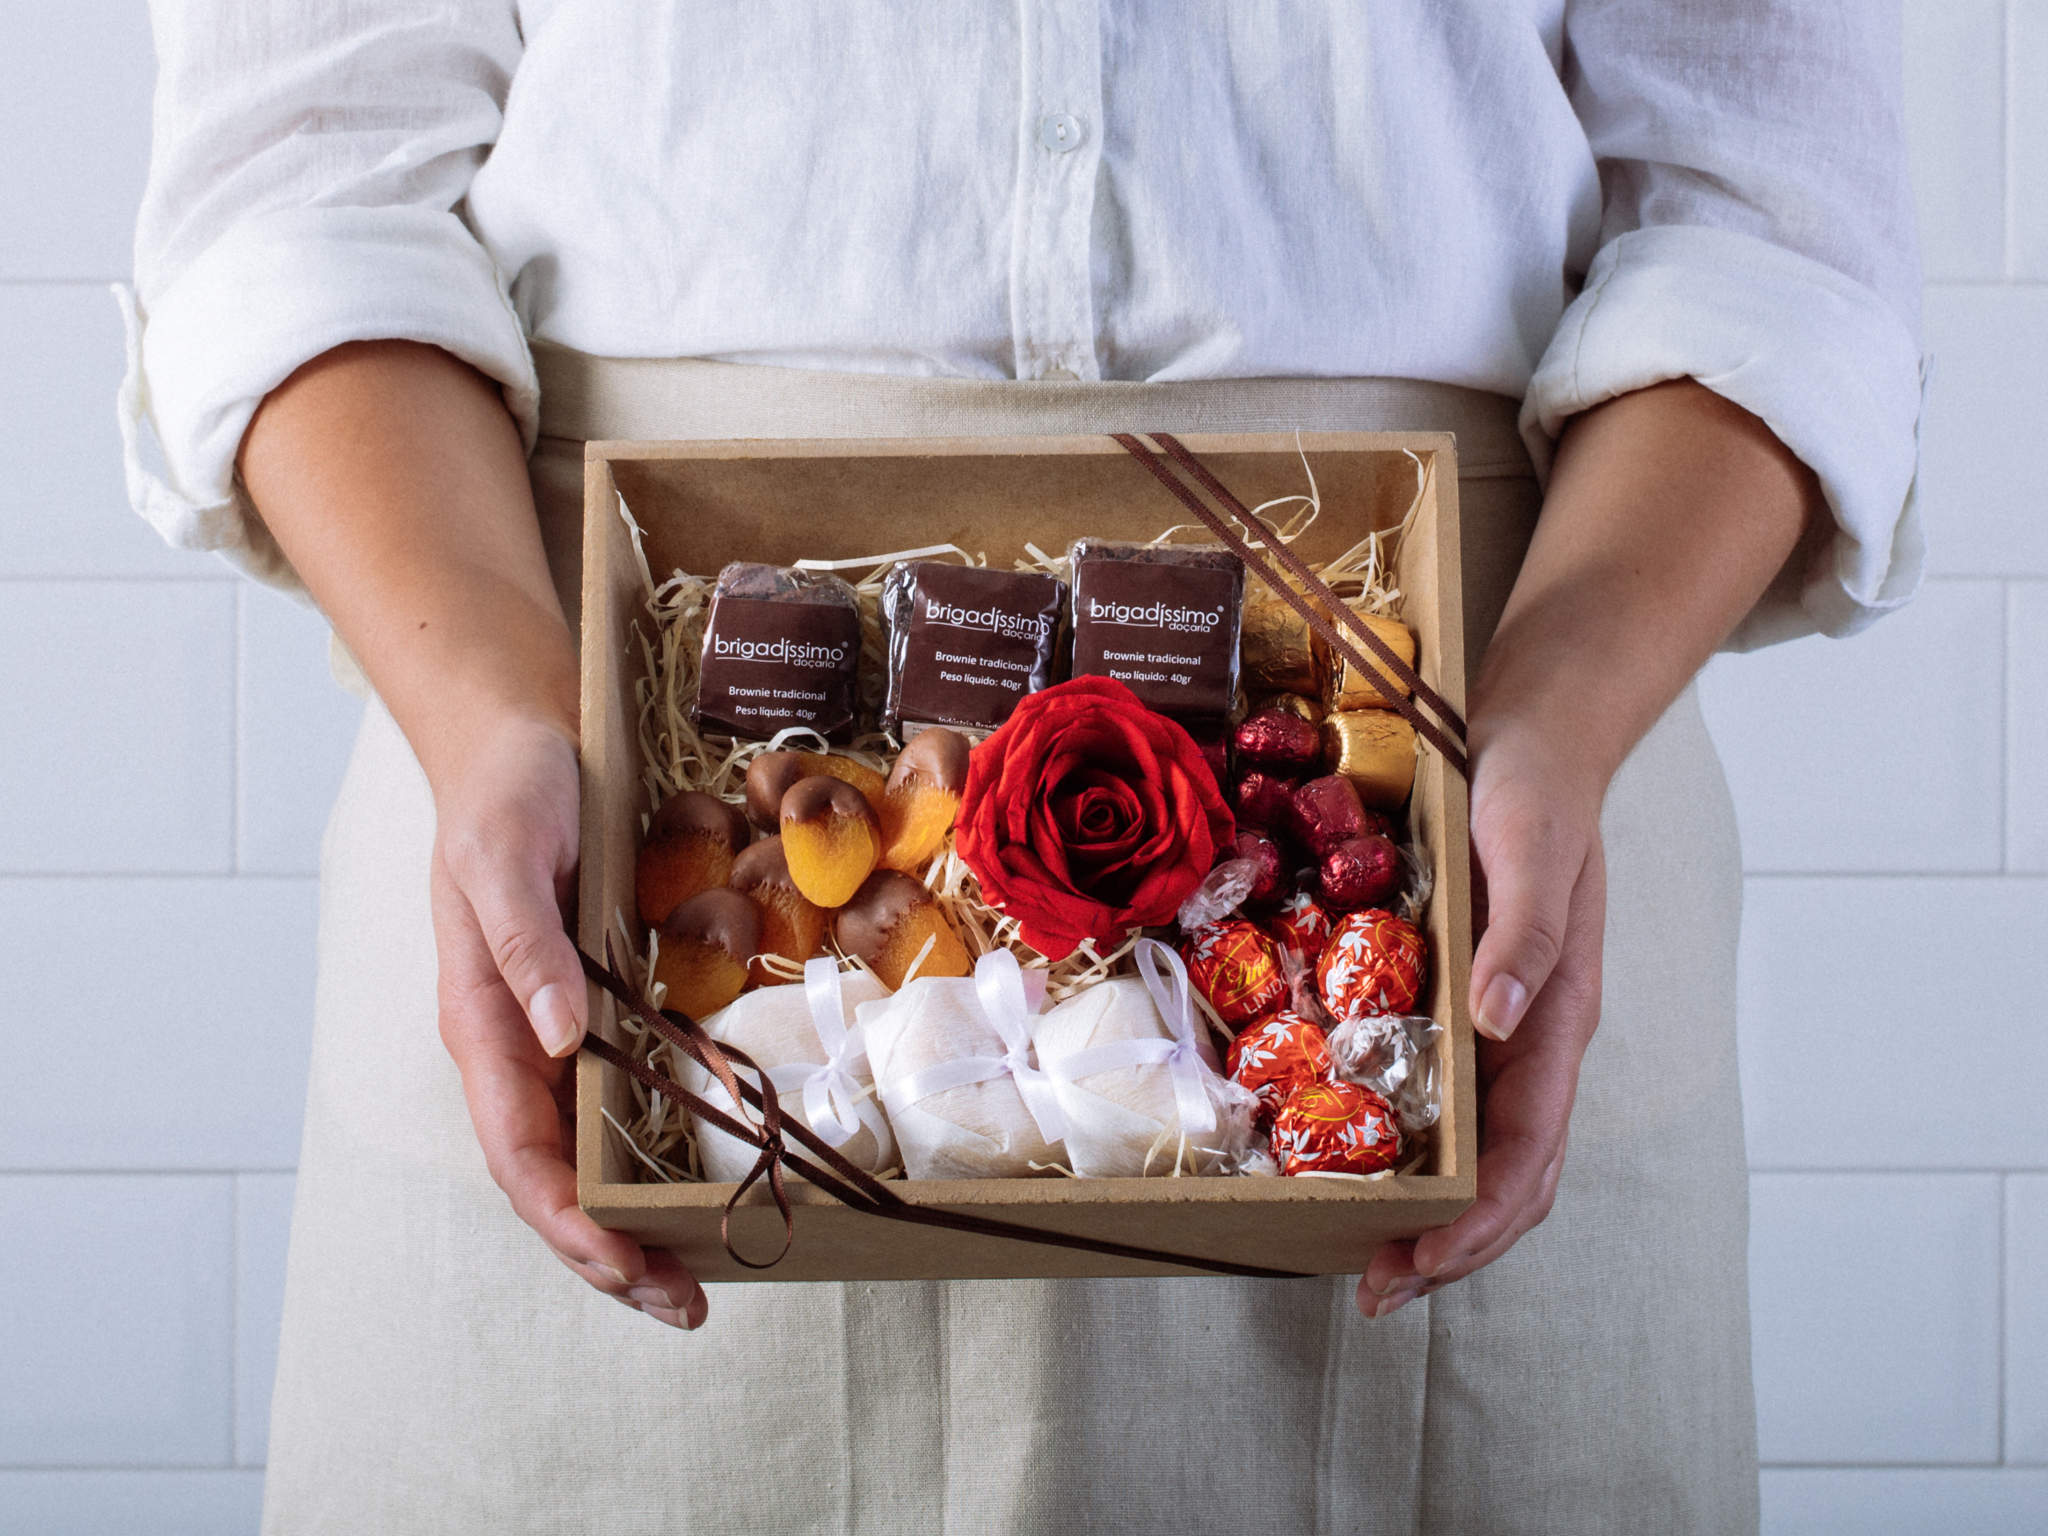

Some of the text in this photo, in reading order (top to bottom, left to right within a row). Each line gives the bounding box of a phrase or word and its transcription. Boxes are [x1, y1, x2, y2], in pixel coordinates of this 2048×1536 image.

[1168, 622, 1211, 633] doçaria
[935, 651, 1033, 673] Brownie tradicional
[1103, 650, 1202, 666] Brownie tradicional
[940, 671, 1022, 691] Peso líquido: 40gr
[1109, 669, 1192, 685] Peso líquido: 40gr
[728, 686, 826, 702] Brownie tradicional
[735, 705, 817, 721] Peso líquido: 40gr
